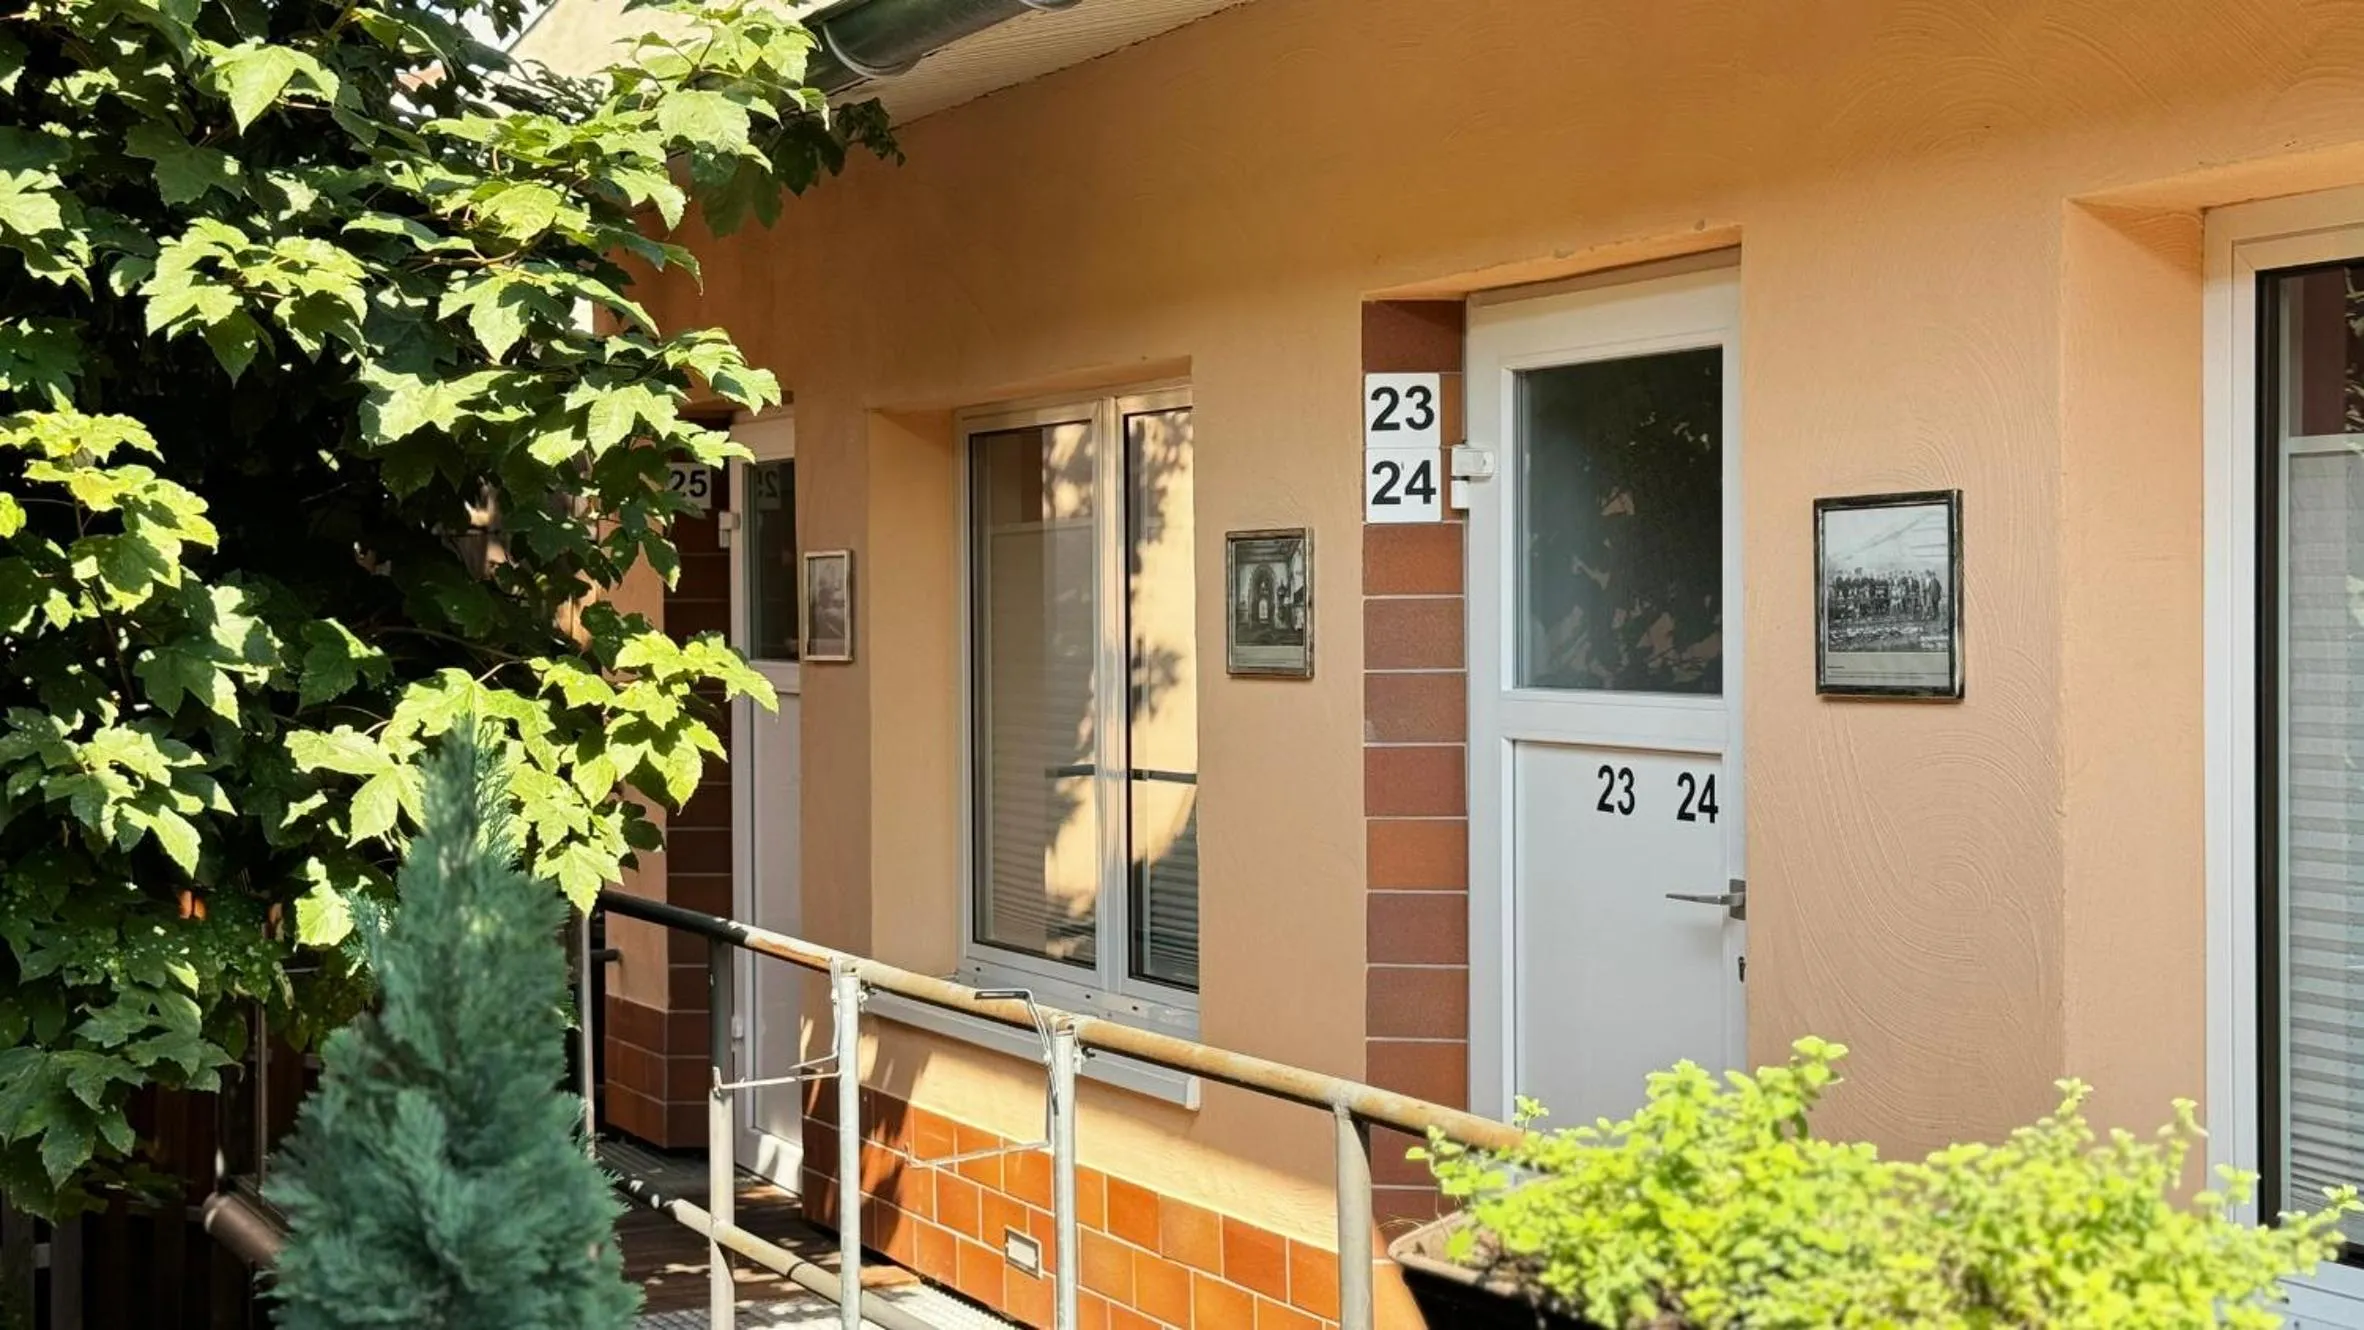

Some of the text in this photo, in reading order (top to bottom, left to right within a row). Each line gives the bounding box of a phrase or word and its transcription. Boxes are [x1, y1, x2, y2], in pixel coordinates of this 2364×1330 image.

[1371, 385, 1435, 431] 23
[670, 470, 707, 498] 25
[1371, 459, 1436, 505] 24
[1597, 764, 1719, 824] 23 24
